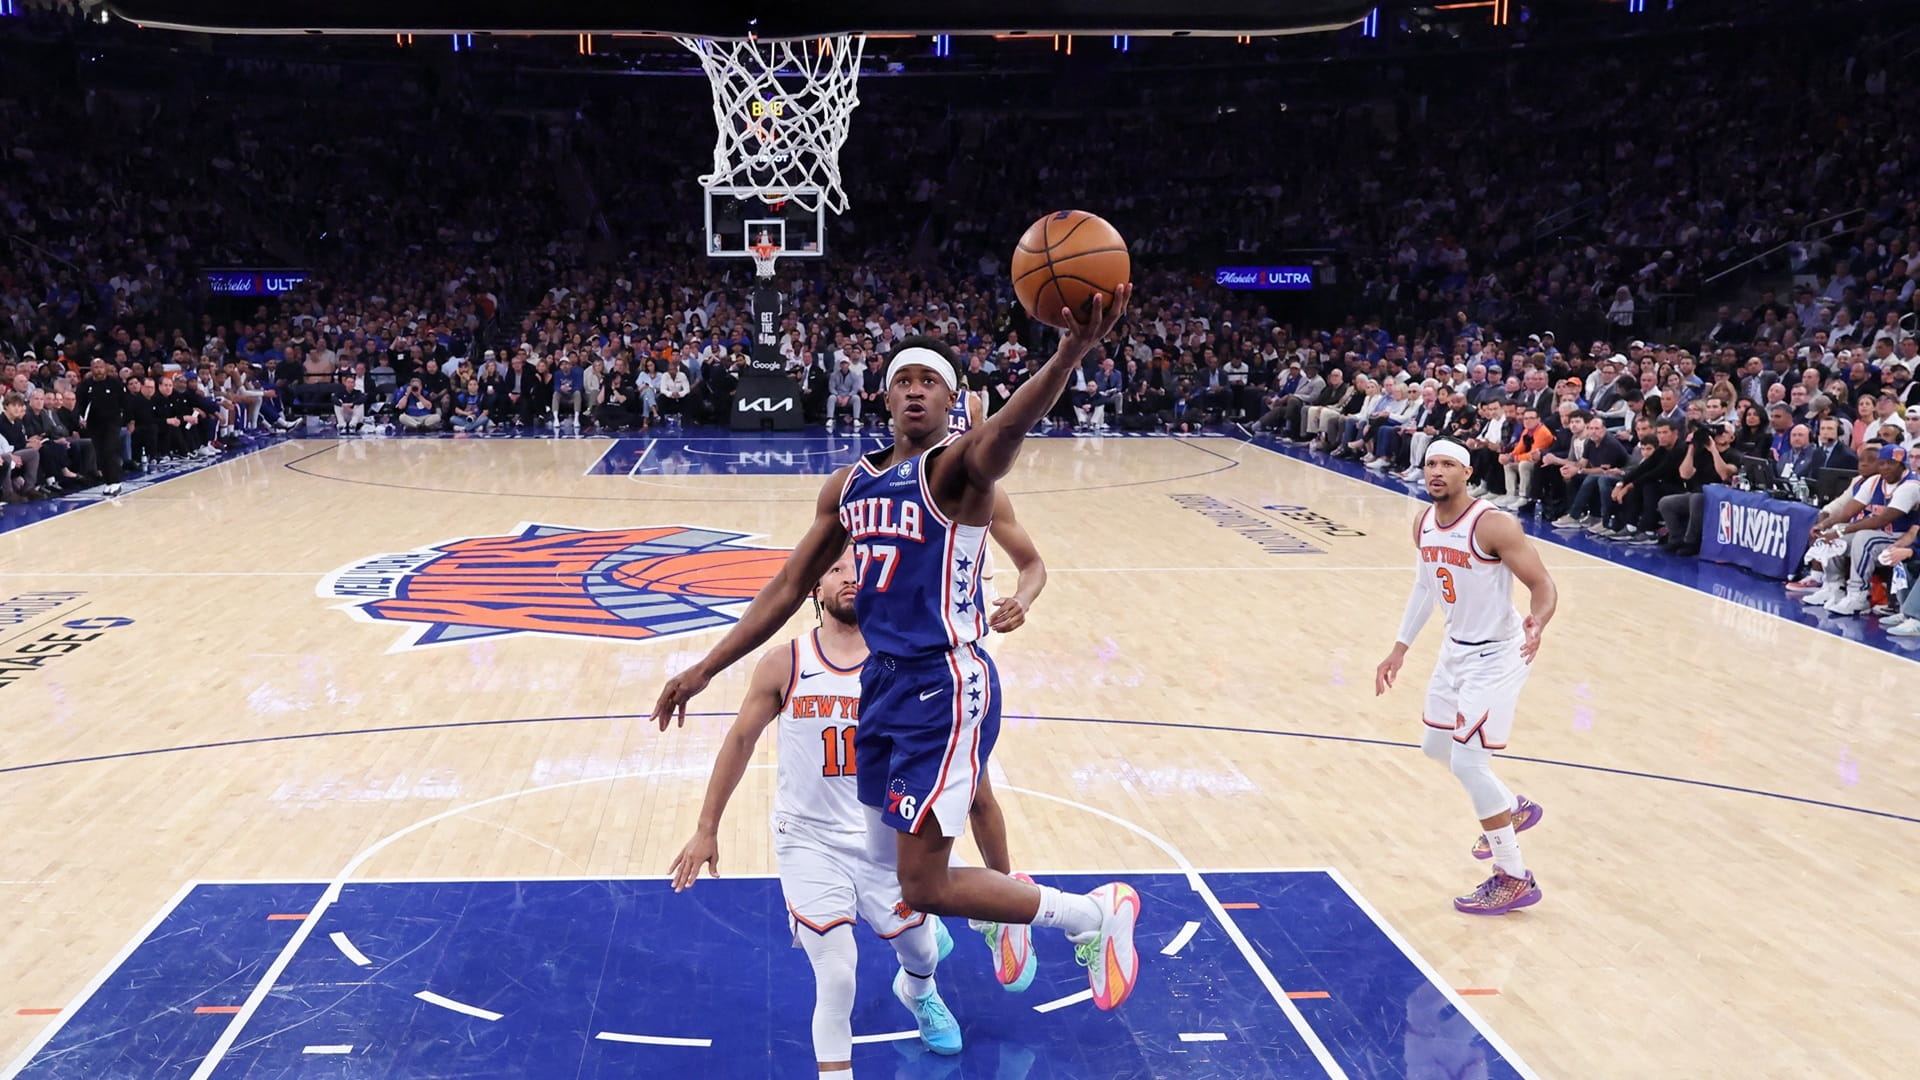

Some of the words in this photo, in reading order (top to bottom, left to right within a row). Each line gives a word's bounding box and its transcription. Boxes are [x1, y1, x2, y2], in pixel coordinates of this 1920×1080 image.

[266, 279, 303, 291] ULT
[1269, 273, 1311, 284] ULTRA
[761, 312, 774, 322] GET
[761, 322, 774, 333] THE
[752, 360, 781, 372] Google
[1732, 504, 1790, 559] PLAYOFFS
[856, 544, 901, 592] 77
[1439, 546, 1473, 570] YORK
[1436, 567, 1457, 605] 3
[0, 632, 105, 689] HASE
[792, 695, 837, 719] NEW
[839, 697, 860, 720] YO
[821, 725, 858, 777] 11
[888, 790, 917, 820] 76
